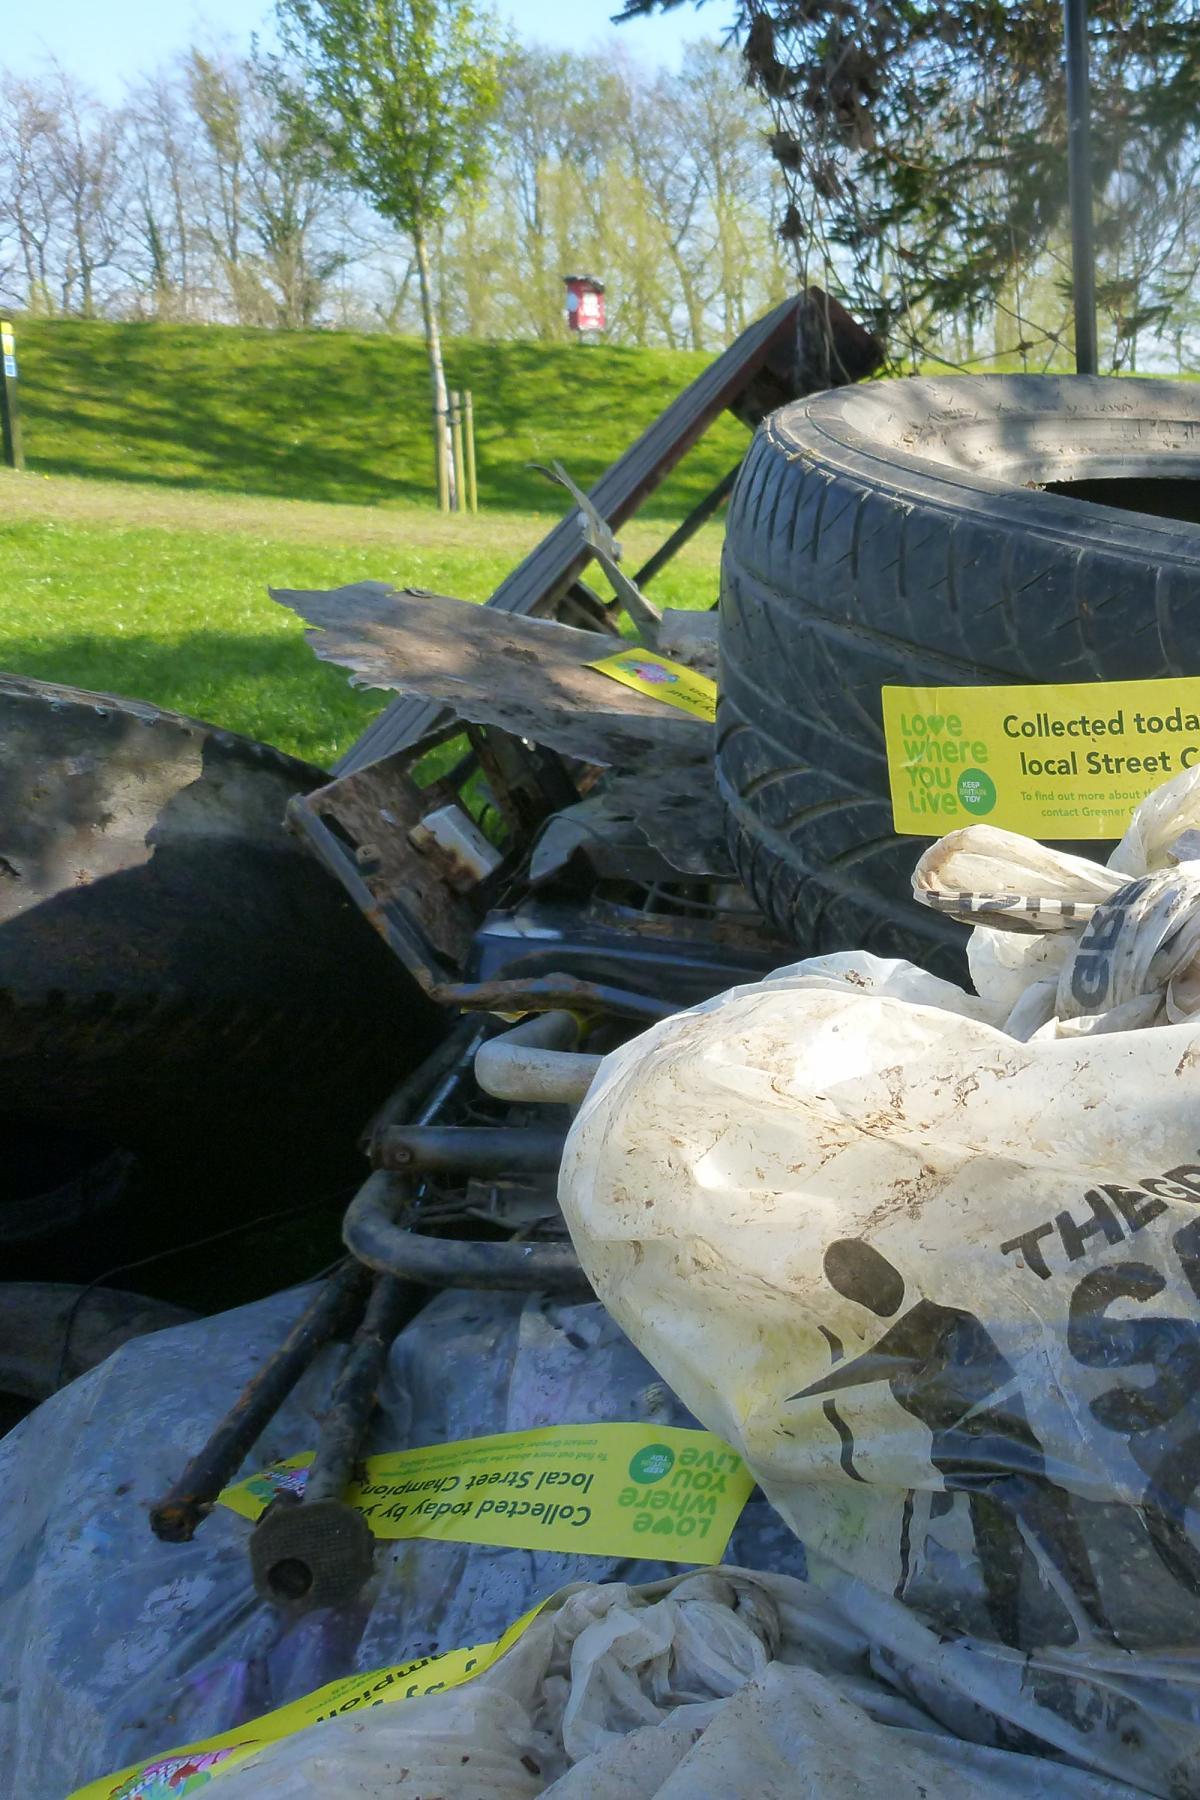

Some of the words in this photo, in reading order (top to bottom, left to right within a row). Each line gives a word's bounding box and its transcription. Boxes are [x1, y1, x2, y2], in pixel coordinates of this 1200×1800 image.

[1003, 710, 1125, 739] Collected
[903, 735, 990, 764] where
[1020, 751, 1078, 776] local
[1086, 751, 1172, 776] Street
[1020, 791, 1032, 801] To
[1035, 790, 1054, 801] find
[1057, 792, 1075, 801] out
[1078, 791, 1105, 801] more
[1108, 789, 1141, 801] about
[1041, 806, 1079, 818] contact
[1082, 805, 1125, 817] Greener
[1000, 1183, 1169, 1281] THE
[360, 1475, 462, 1499] Champion
[464, 1470, 535, 1490] Street
[534, 1471, 595, 1494] local
[379, 1502, 407, 1523] by
[409, 1498, 474, 1521] today
[474, 1499, 592, 1527] Collected
[617, 1486, 718, 1517] where
